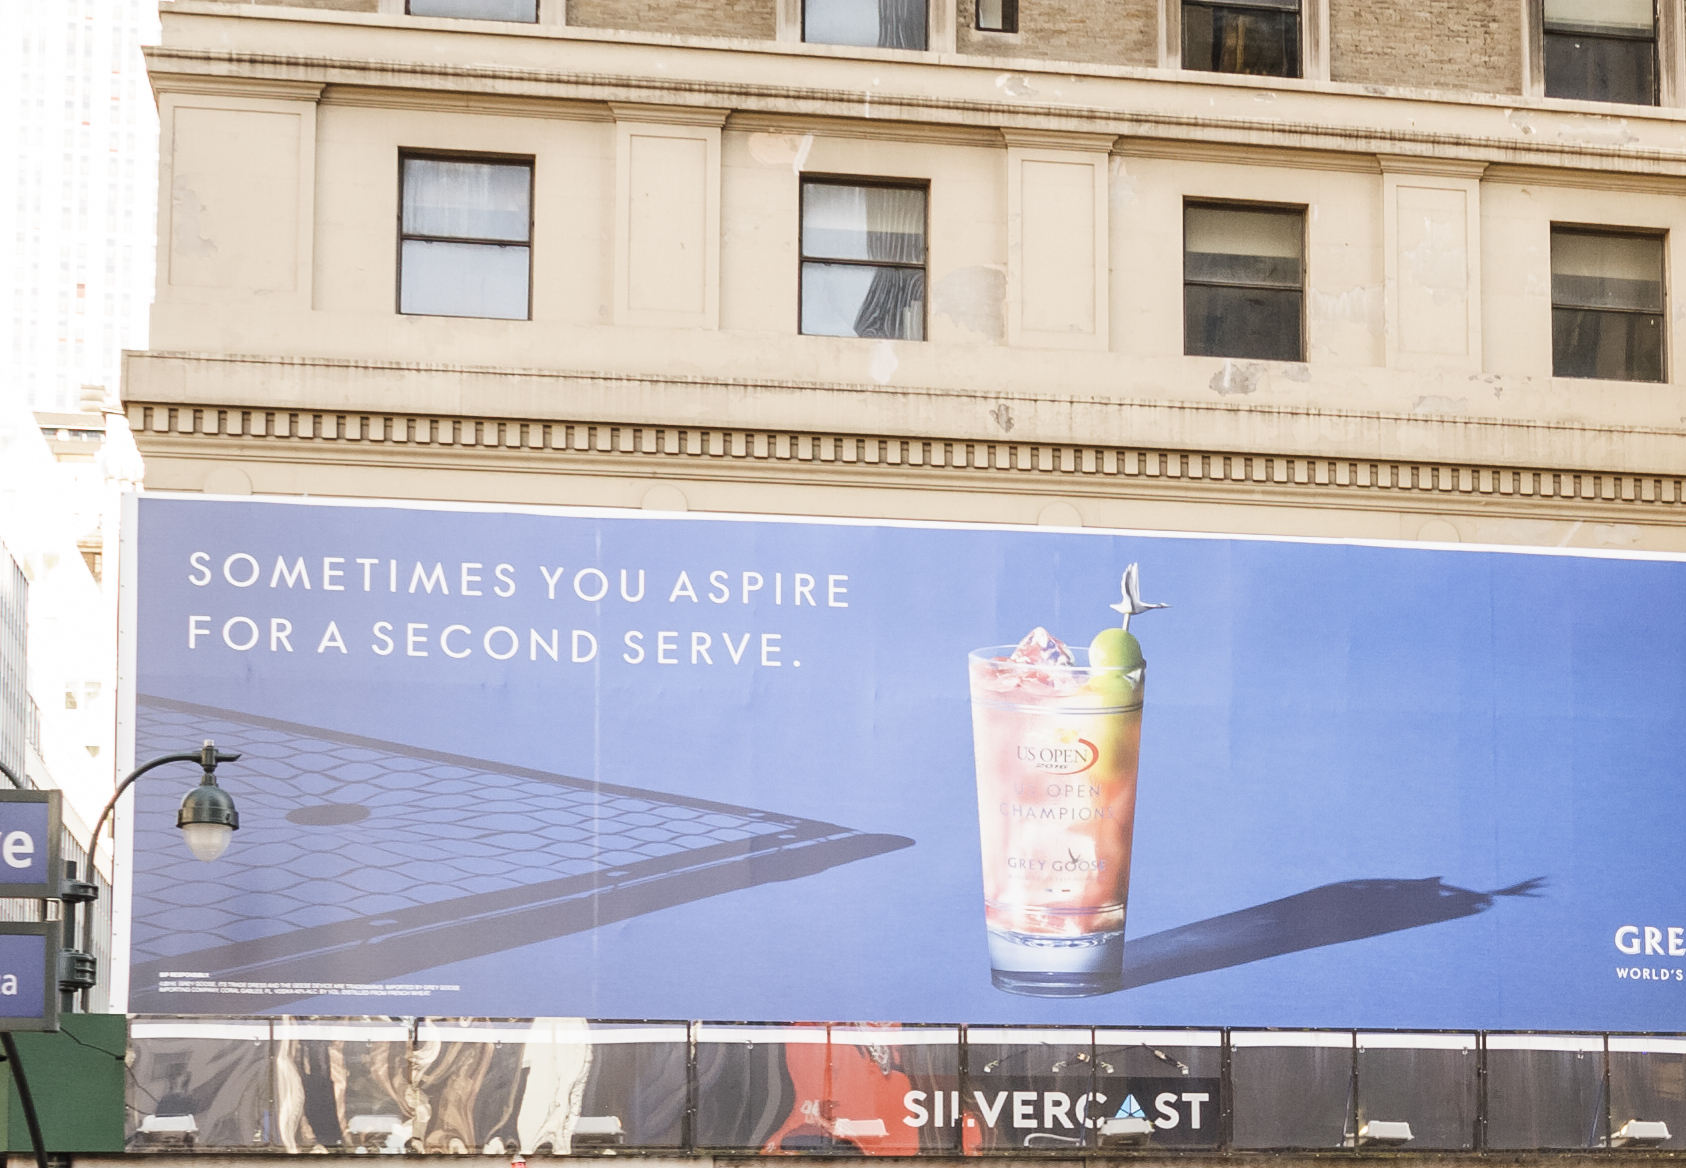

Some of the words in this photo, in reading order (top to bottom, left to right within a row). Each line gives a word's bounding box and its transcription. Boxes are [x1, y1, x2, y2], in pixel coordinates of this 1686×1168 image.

[188, 551, 517, 598] SOMETIMES
[539, 565, 646, 603] YOU
[669, 570, 850, 608] ASPIRE
[188, 615, 294, 653] FOR
[317, 621, 348, 654] A
[371, 621, 598, 664] SECOND
[622, 630, 802, 667] SERVE.
[1016, 745, 1036, 762] US
[1040, 748, 1088, 764] OPEN
[1046, 784, 1101, 798] OPEN
[999, 802, 1114, 821] CHAMPIONS
[1007, 857, 1046, 871] GREY
[1051, 860, 1106, 872] GOOSE
[1616, 967, 1684, 981] WORLD'S
